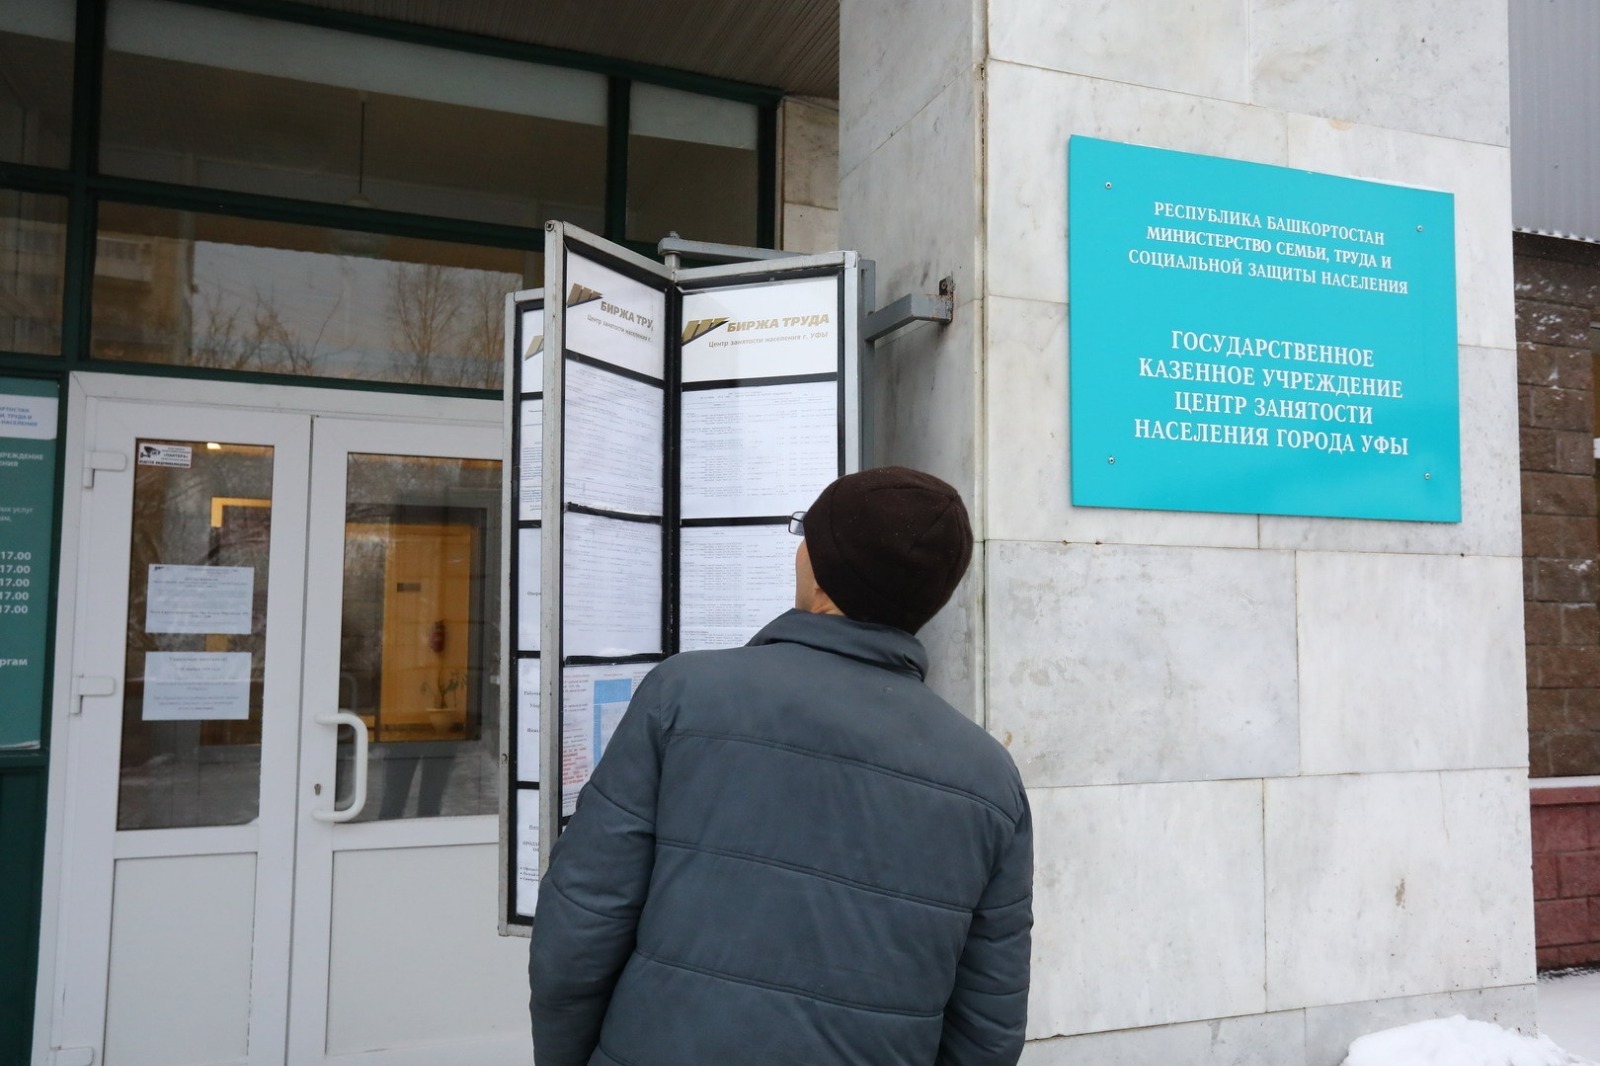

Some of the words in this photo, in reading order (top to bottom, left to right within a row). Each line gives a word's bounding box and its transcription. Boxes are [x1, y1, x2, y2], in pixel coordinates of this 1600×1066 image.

[1154, 202, 1262, 228] РЕСПУБЛИКА
[1267, 216, 1385, 246] БАШКОРТОСТАН
[1146, 227, 1271, 253] МИНИСТЕРСТВО
[1276, 241, 1330, 263] СЕМЬИ,
[1334, 249, 1377, 268] ТРУДА
[1381, 256, 1392, 269] И
[1129, 249, 1243, 275] СОЦИАЛЬНОЙ
[1248, 263, 1316, 284] ЗАЩИТЫ
[1321, 273, 1408, 294] НАСЕЛЕНИЯ
[587, 314, 602, 325] Центр
[602, 320, 624, 332] занятости
[625, 330, 647, 341] населения
[600, 301, 634, 322] БИРЖА
[636, 315, 654, 332] ТРУ
[727, 319, 778, 333] БИРЖА
[782, 314, 829, 328] ТРУДА
[708, 341, 729, 349] Центр
[765, 335, 801, 343] населения
[810, 331, 828, 339] УФЫ
[1171, 331, 1374, 368] ГОСУДАРСТВЕННОЕ
[1139, 358, 1255, 386] КАЗЕННОЕ
[1262, 370, 1403, 398] УЧРЕЖДЕНИЕ
[1174, 392, 1247, 414] ЦЕНТР
[1254, 398, 1373, 425] ЗАНЯТОСТИ
[1134, 419, 1269, 446] НАСЕЛЕНИЯ
[1277, 429, 1355, 454] ГОРОДА
[1362, 435, 1408, 456] УФЫ
[0, 565, 30, 574] 17.00
[1, 552, 31, 560] 17.00
[0, 578, 29, 587] 17.00
